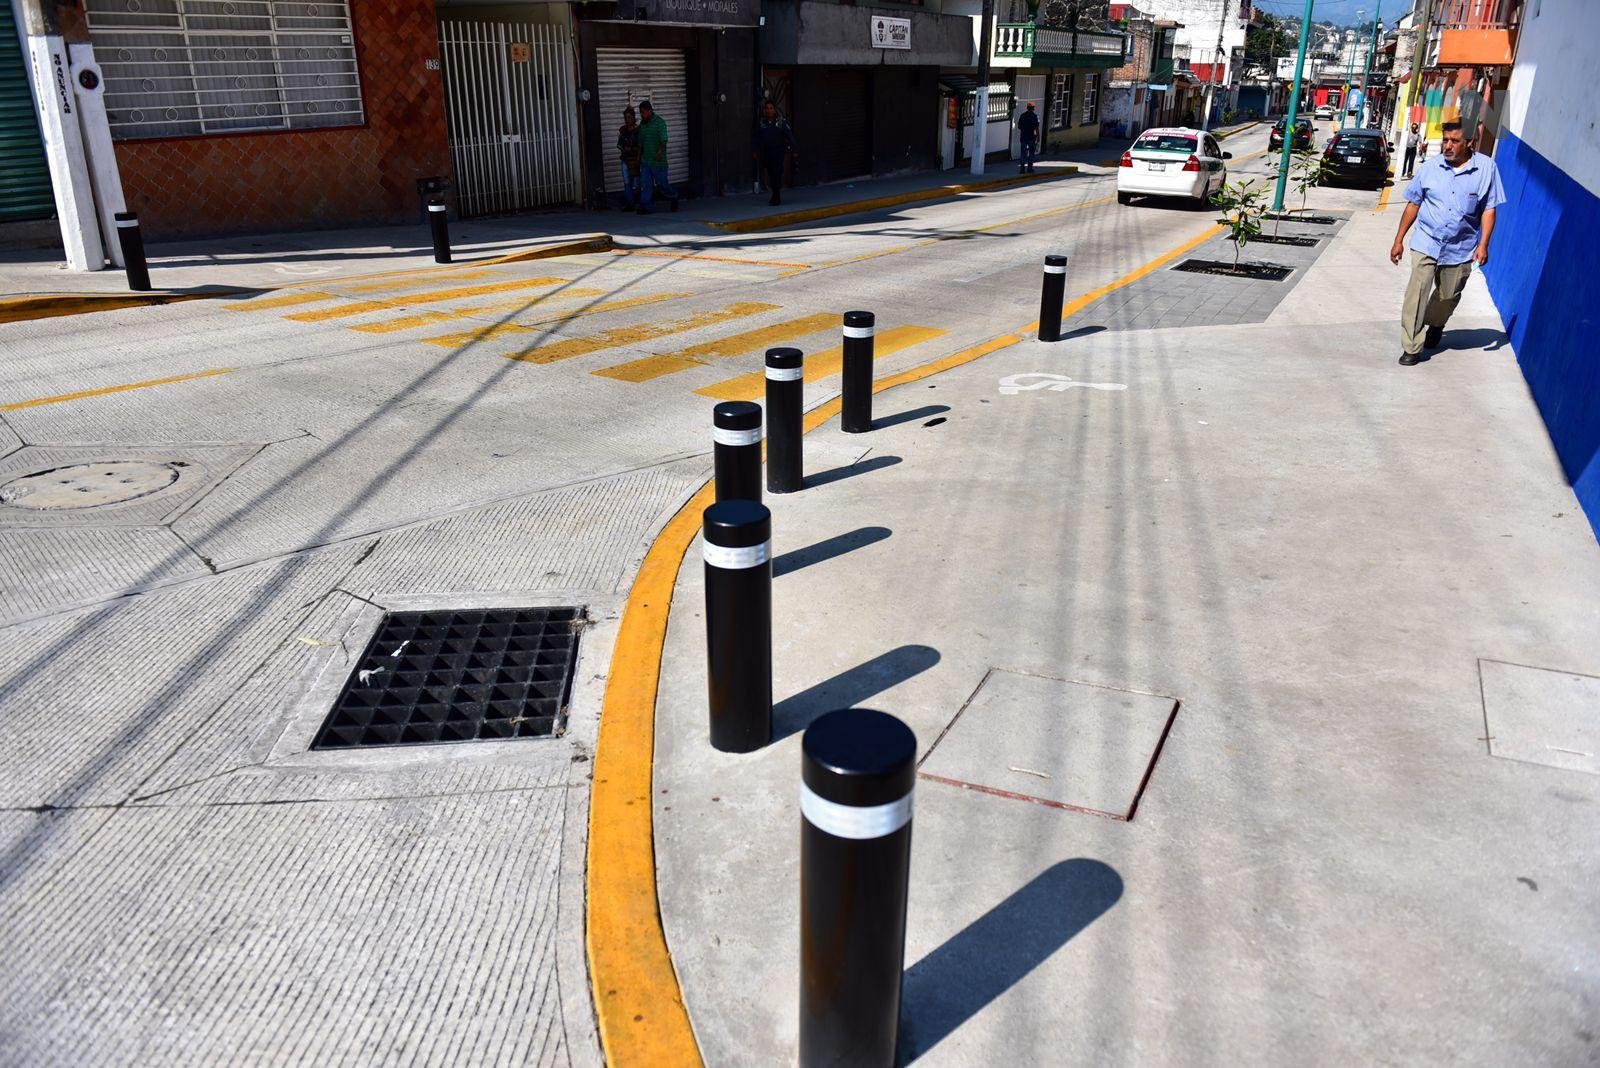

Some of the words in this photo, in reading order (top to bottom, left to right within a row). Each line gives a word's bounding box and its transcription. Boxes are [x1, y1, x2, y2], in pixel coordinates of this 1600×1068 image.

[707, 1, 738, 13] MORALES
[53, 53, 61, 65] NO
[425, 59, 440, 70] 139
[56, 66, 71, 113] ANUNCIAR
